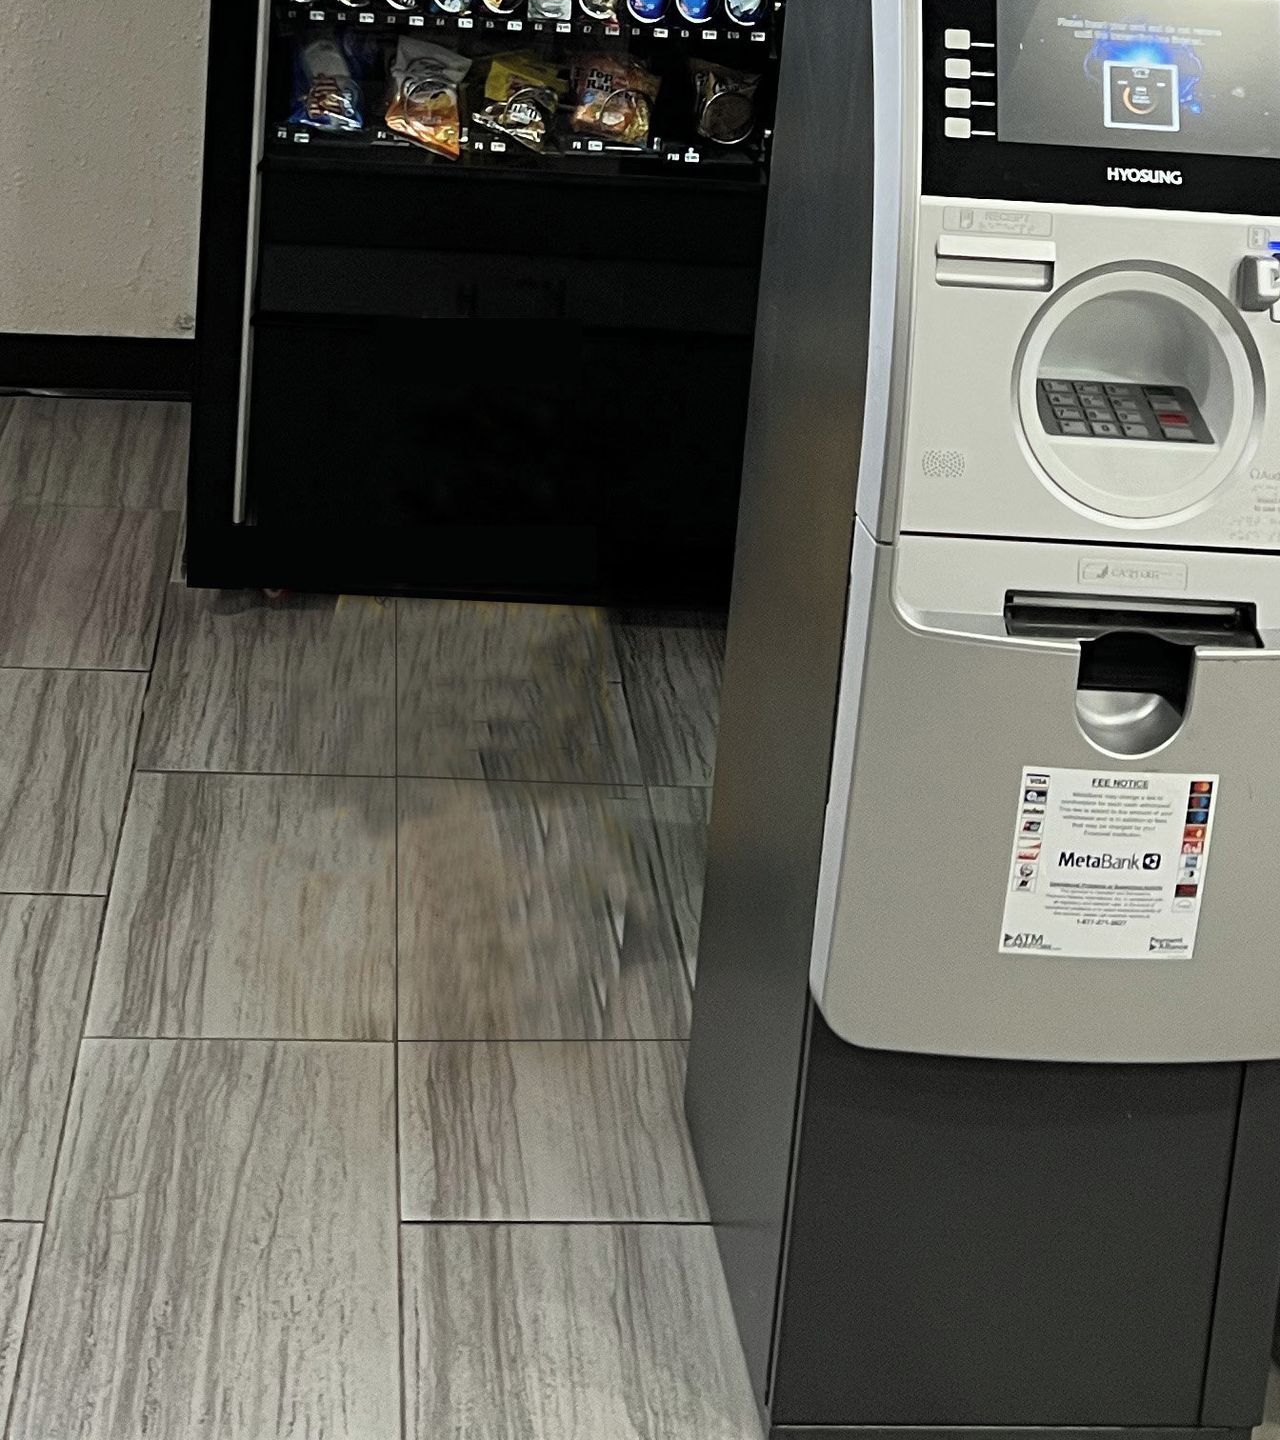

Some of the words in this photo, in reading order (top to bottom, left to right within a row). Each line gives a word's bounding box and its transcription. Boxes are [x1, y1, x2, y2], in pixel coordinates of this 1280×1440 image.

[588, 67, 613, 85] Top
[1107, 167, 1183, 185] HYOSUNG
[1091, 777, 1111, 788] FEE
[1113, 779, 1149, 790] NOTICE
[1058, 851, 1140, 870] MetaBank
[1014, 933, 1044, 946] ATM
